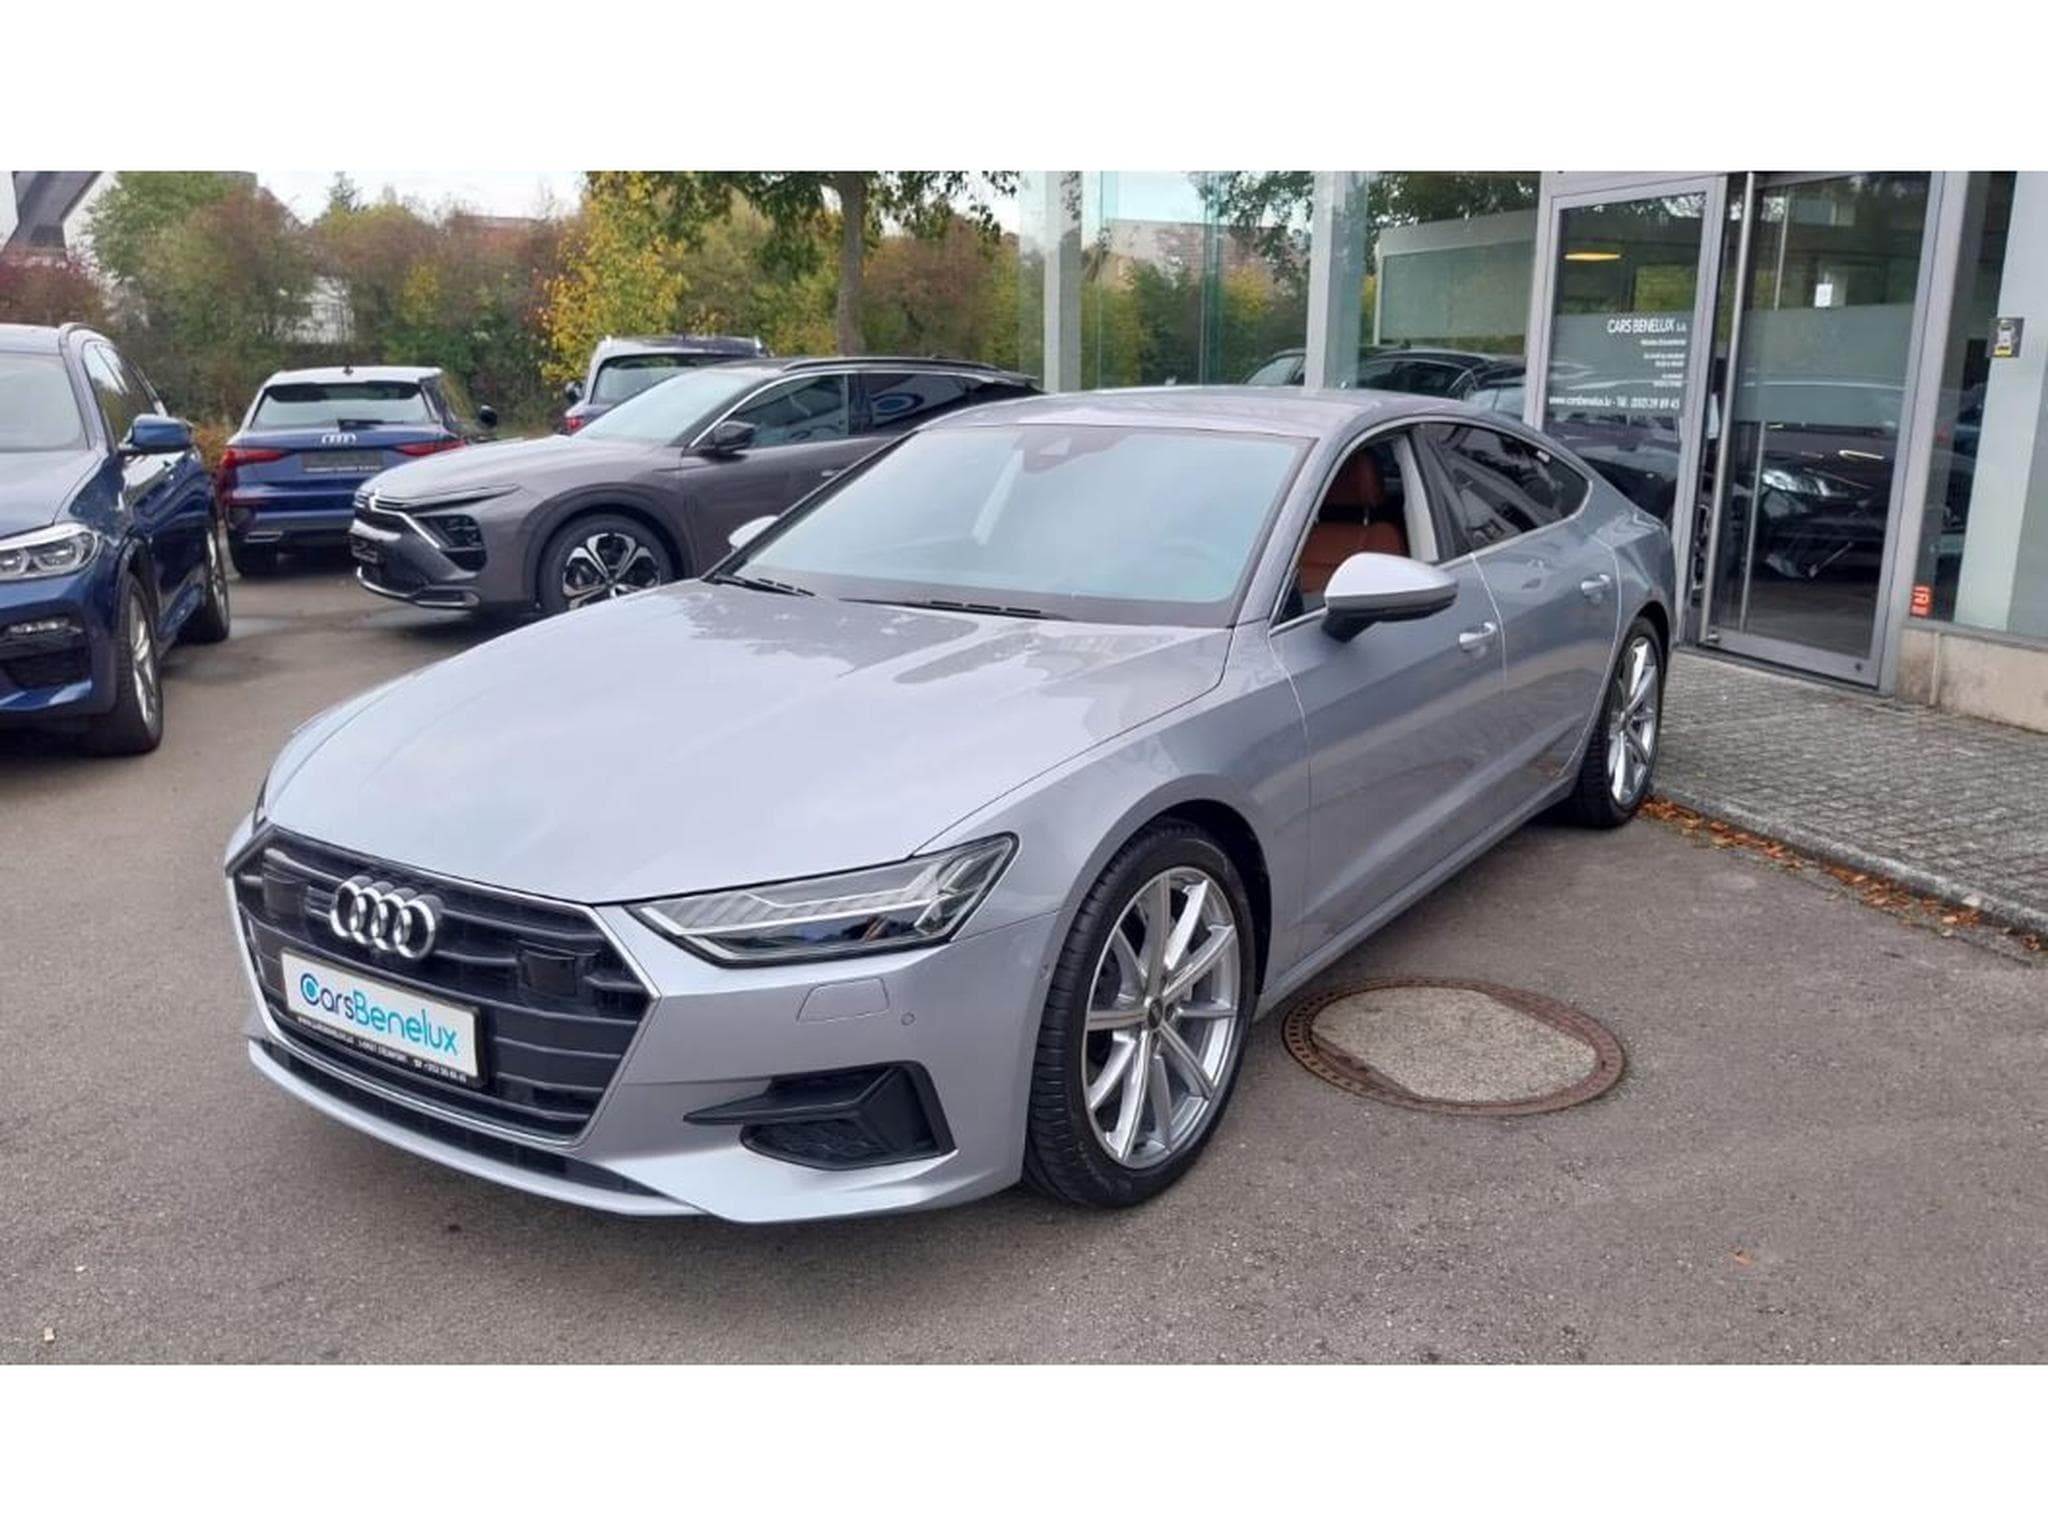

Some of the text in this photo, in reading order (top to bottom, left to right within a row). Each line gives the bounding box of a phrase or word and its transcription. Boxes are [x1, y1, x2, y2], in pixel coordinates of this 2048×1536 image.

[1607, 318, 1632, 333] CARS
[1633, 317, 1676, 333] BENELUX
[300, 973, 458, 1056] CarsBenelux
